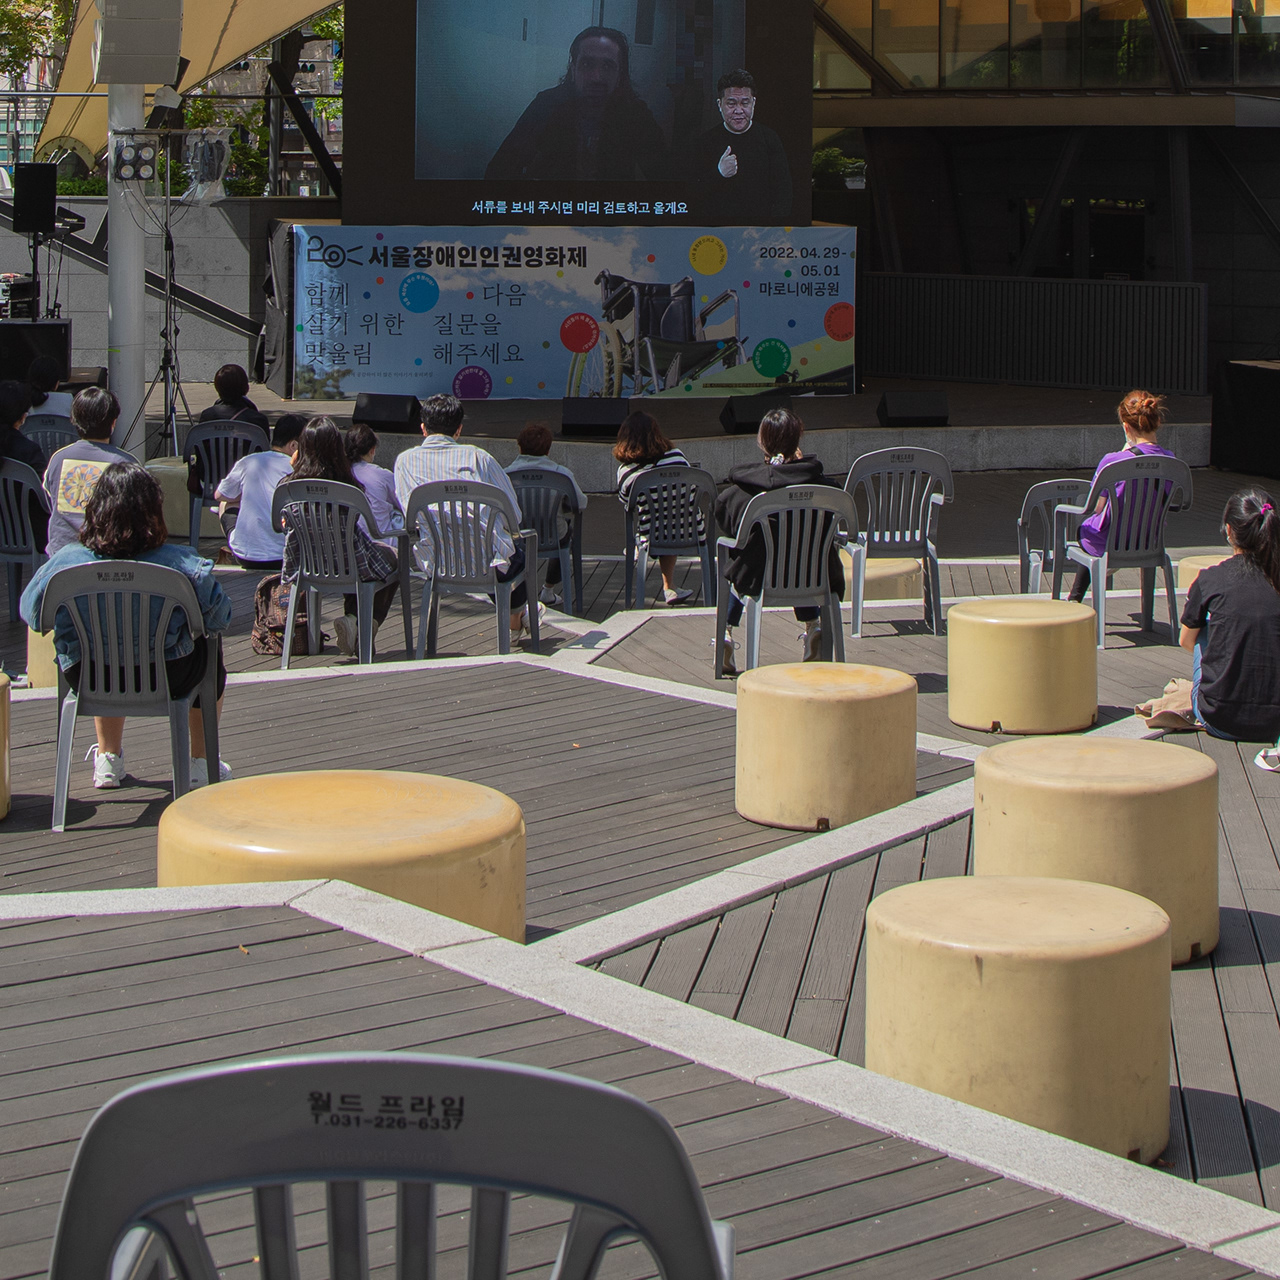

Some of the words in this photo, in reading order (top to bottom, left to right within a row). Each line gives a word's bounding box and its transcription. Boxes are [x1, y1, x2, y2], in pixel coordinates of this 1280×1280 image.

[472, 200, 508, 214] 서류를
[511, 200, 535, 214] 보내
[537, 200, 573, 214] 주시면
[577, 200, 600, 214] 미리
[603, 200, 650, 215] 검토하고
[653, 200, 689, 215] 올게요
[368, 244, 588, 269] 서울장애인인권영화제
[305, 282, 350, 307] 함께
[483, 283, 526, 307] 다음
[759, 281, 840, 297] 마로니에공원
[304, 312, 348, 336] 살기
[359, 312, 405, 336] 위한
[433, 312, 502, 336] 질문을
[305, 342, 372, 365] 맞울림
[433, 341, 525, 365] 해주세요
[308, 1090, 364, 1113] 월드
[377, 1095, 465, 1118] 프라임
[311, 1111, 463, 1131] T.031-226-6337
